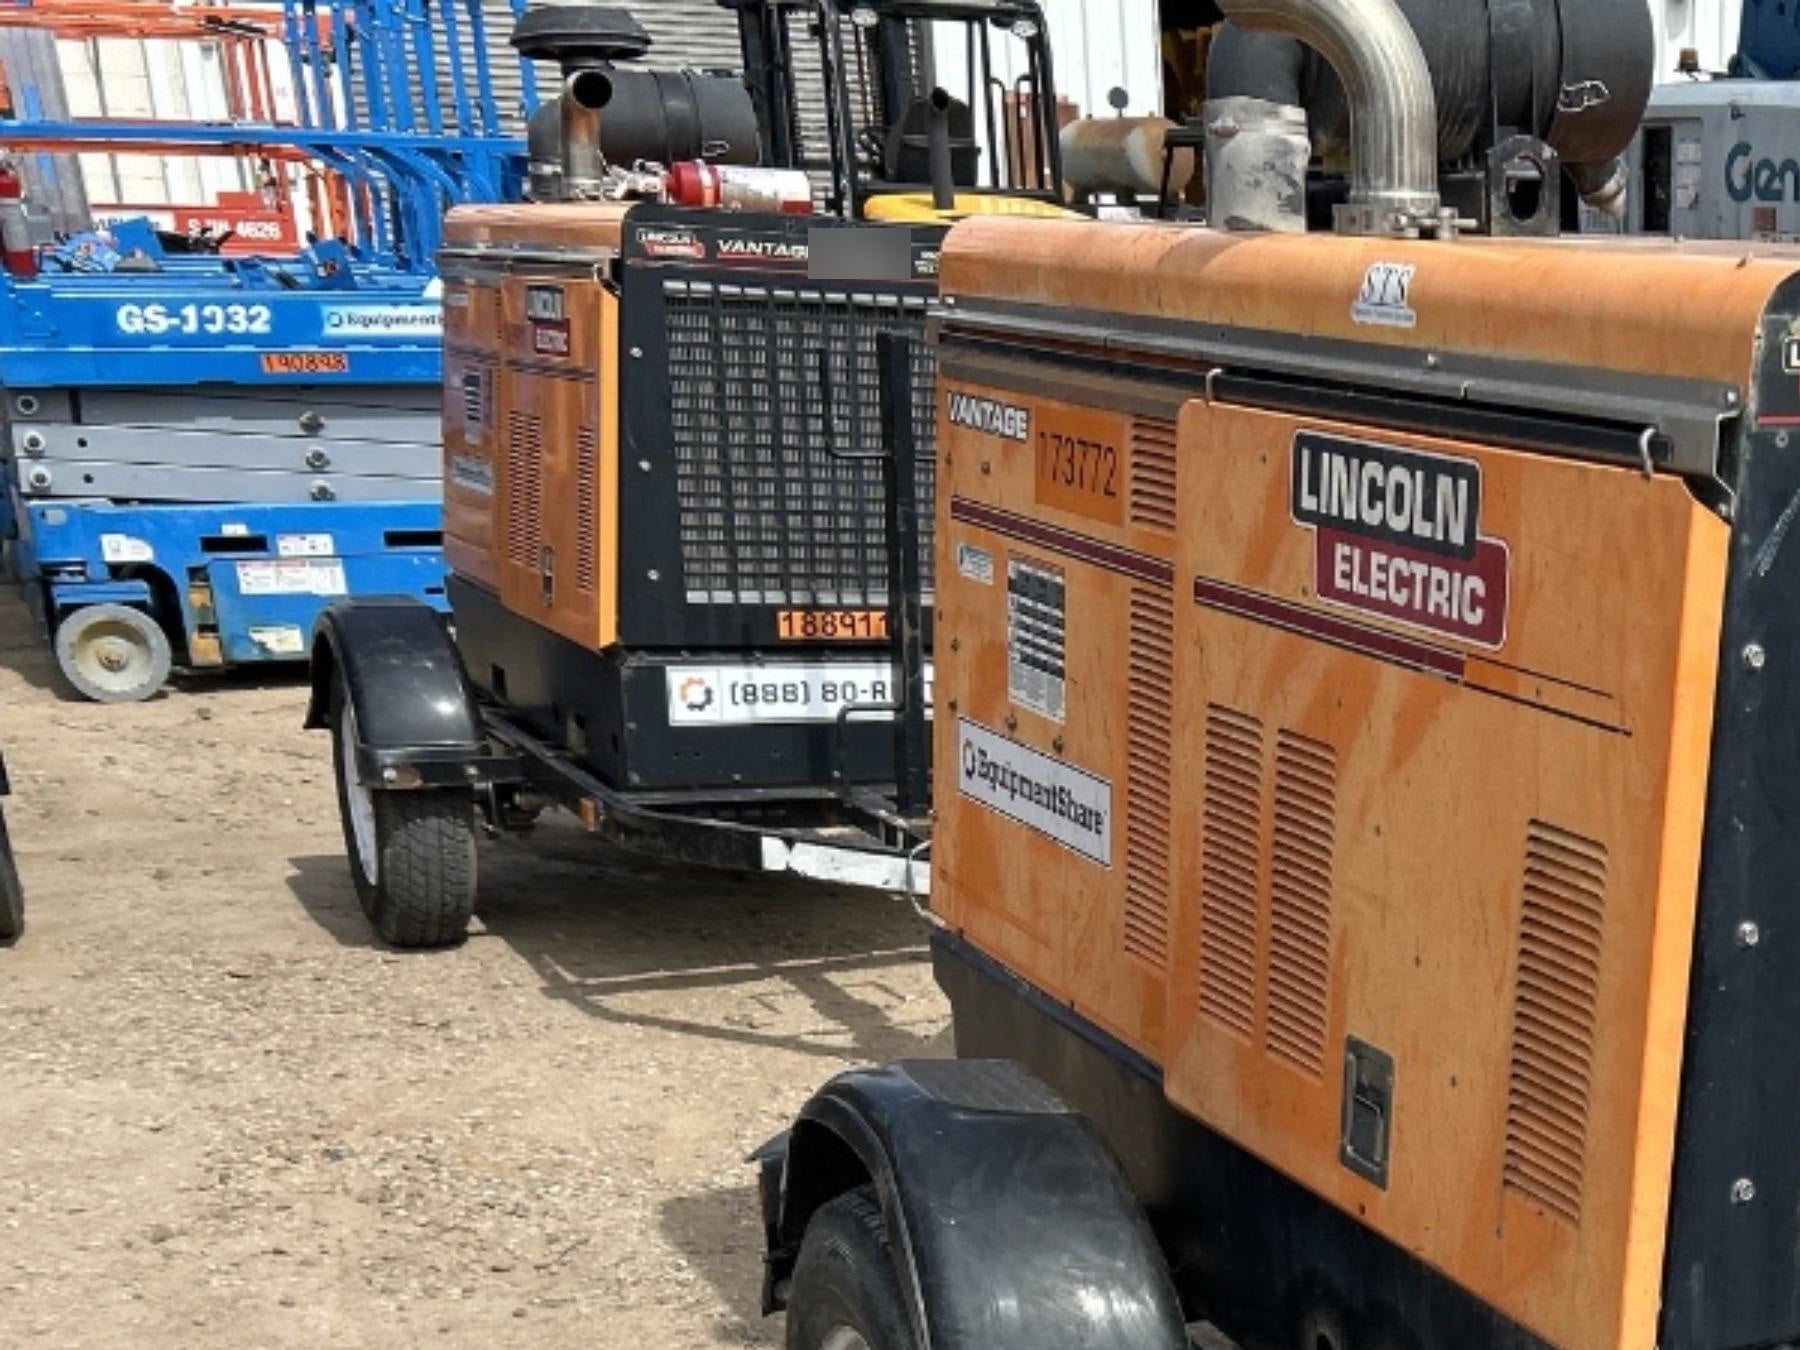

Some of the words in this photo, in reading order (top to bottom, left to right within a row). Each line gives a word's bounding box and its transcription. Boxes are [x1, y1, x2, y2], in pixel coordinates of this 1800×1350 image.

[347, 312, 443, 330] Equipment
[947, 391, 1028, 441] VANTAGE
[1040, 432, 1117, 498] 173772
[1301, 448, 1468, 547] LINCOLN
[1335, 542, 1487, 626] ELECTRIC
[781, 611, 890, 637] 188911
[730, 681, 811, 706] (888)
[977, 747, 1104, 836] EquipmentShare
